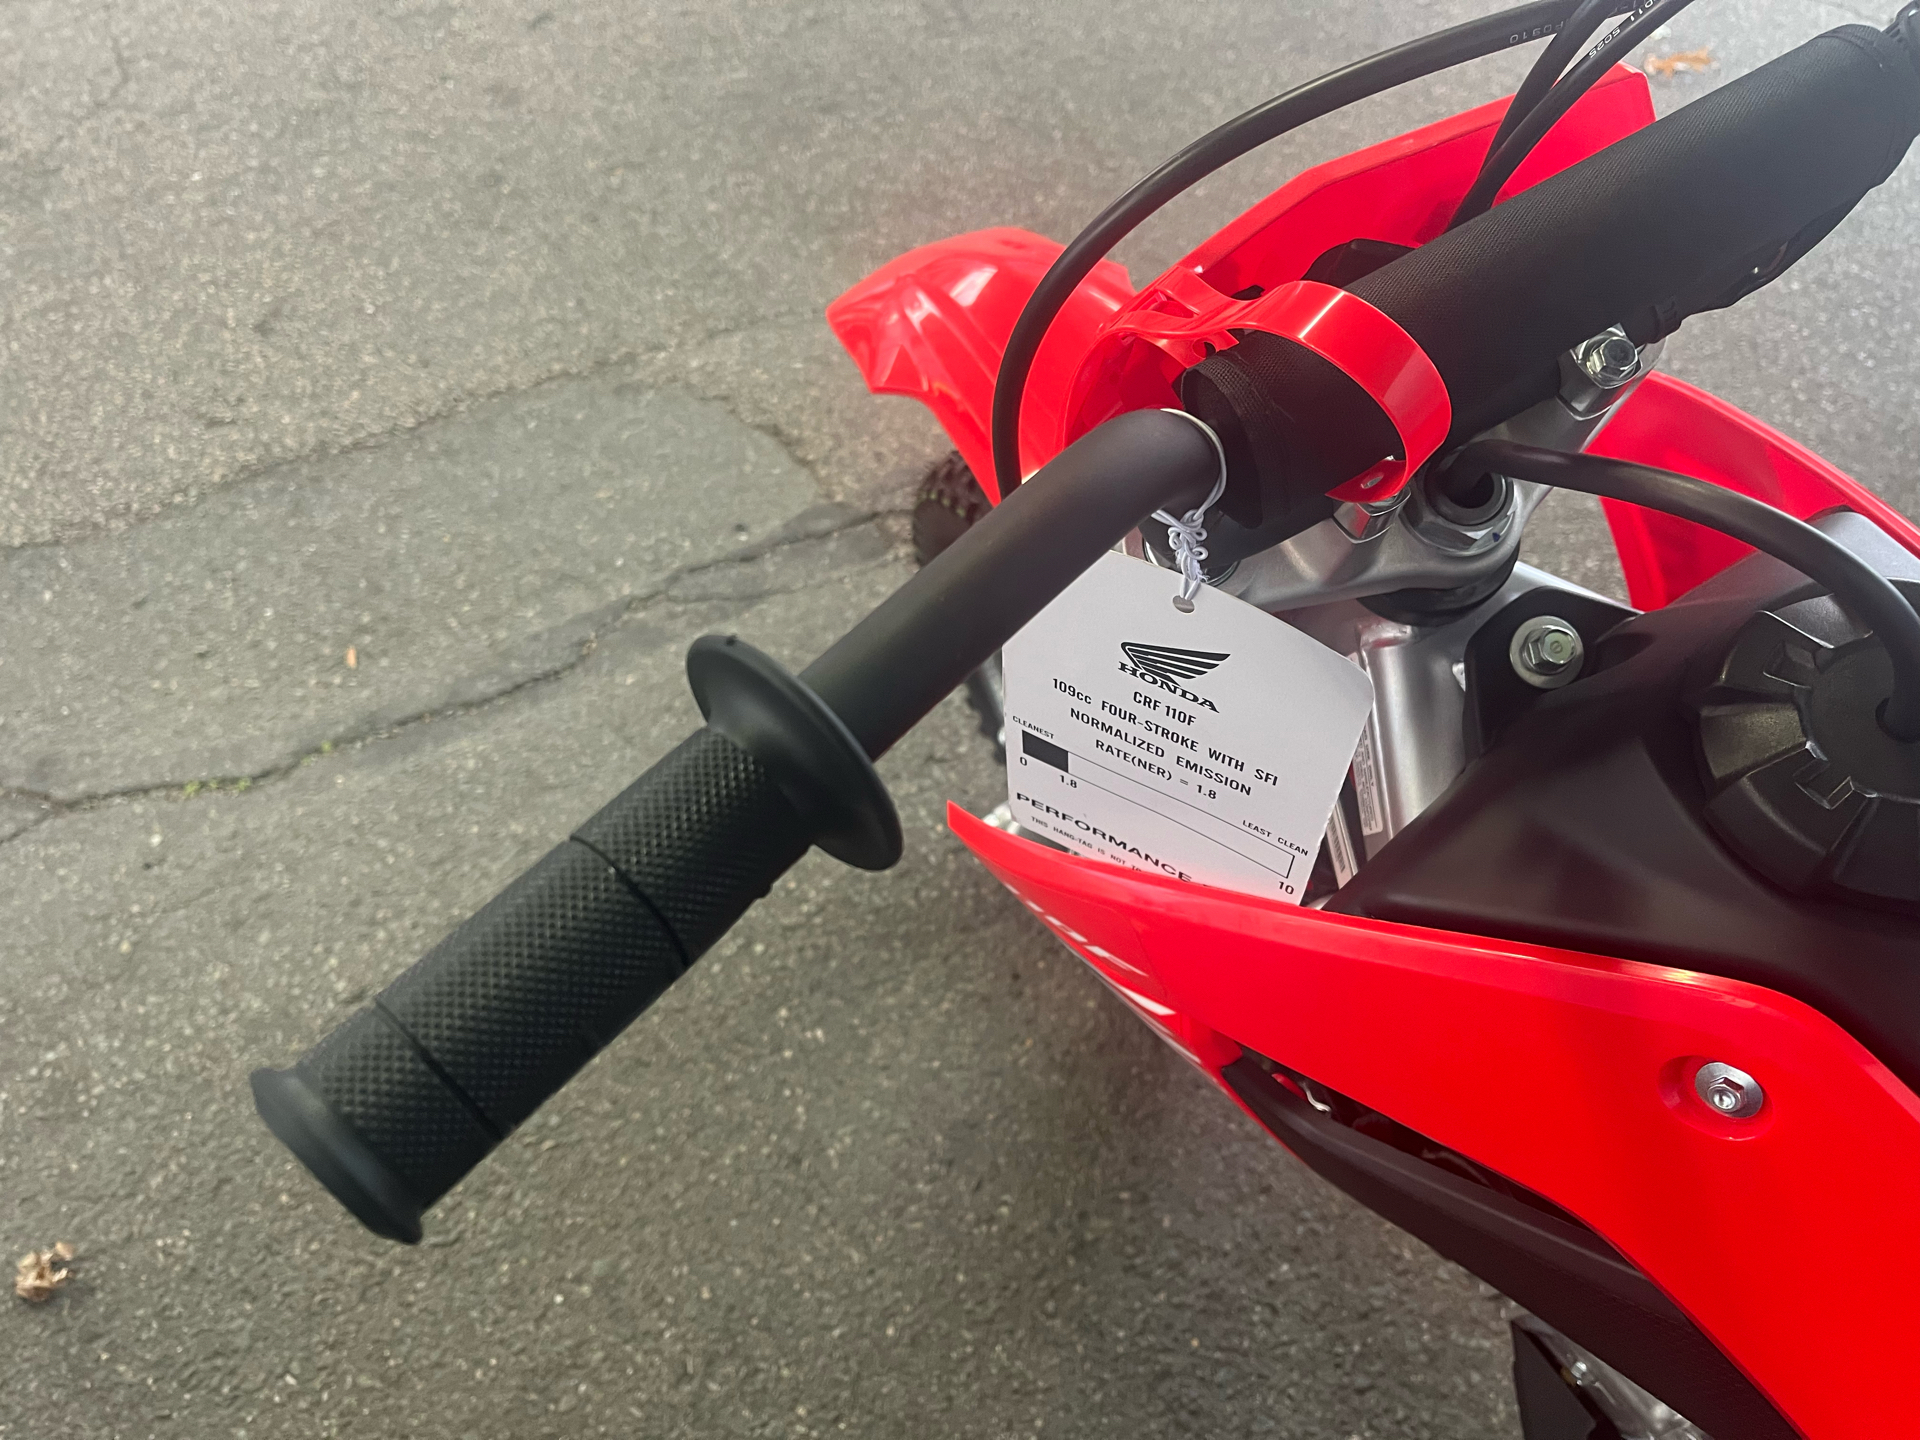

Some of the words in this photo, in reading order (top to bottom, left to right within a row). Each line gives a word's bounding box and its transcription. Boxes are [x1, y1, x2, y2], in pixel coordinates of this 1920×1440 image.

[1118, 661, 1220, 714] HONDA
[1133, 691, 1161, 711] CRF
[1165, 705, 1197, 726] 110F
[1012, 715, 1055, 740] CLEANEST
[1052, 678, 1092, 705] 109cc
[1101, 700, 1199, 752] FOUR-STROKE
[1208, 747, 1245, 772] WITH
[1254, 768, 1278, 786] SFI
[1019, 756, 1028, 766] 0
[1070, 707, 1165, 758] NORMALIZED
[1176, 755, 1251, 796] EMISSION
[1095, 739, 1172, 781] RATE(NER)
[1196, 784, 1217, 800] 1.8
[1060, 774, 1078, 789] 1.8
[1016, 792, 1193, 883] PERFORMANCE
[1031, 816, 1049, 828] THIS
[1053, 826, 1093, 849] HANG-TAG
[1097, 847, 1105, 855] IS
[1110, 854, 1126, 866] NOT
[1242, 819, 1273, 838] LEAST
[1277, 836, 1309, 857] CLEAN
[1278, 881, 1295, 895] 10
